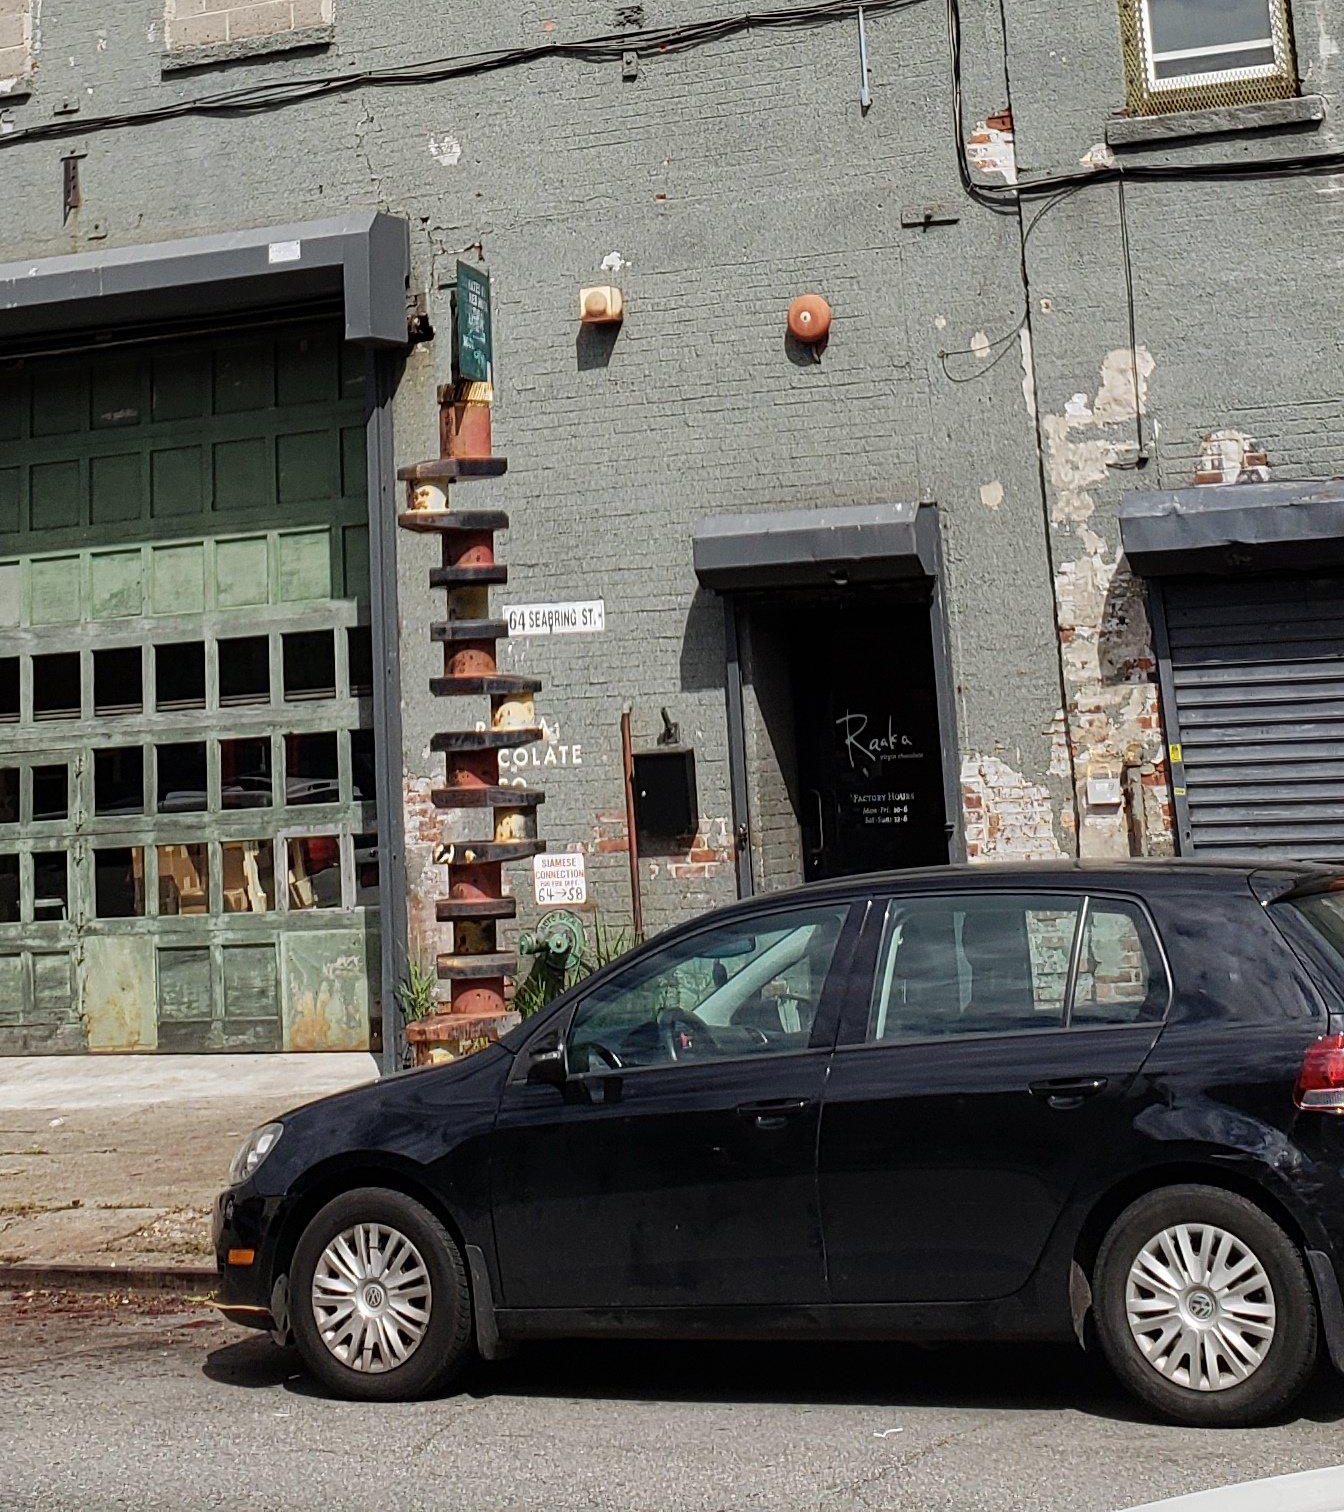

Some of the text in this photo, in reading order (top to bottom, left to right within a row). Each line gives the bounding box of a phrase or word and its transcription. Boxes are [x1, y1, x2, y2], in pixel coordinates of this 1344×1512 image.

[509, 610, 525, 631] 64
[528, 608, 577, 629] SEABRING
[836, 709, 913, 768] Raaka
[497, 744, 583, 768] COLATE
[535, 868, 585, 880] CONNECTION
[541, 857, 578, 868] SIAMESE
